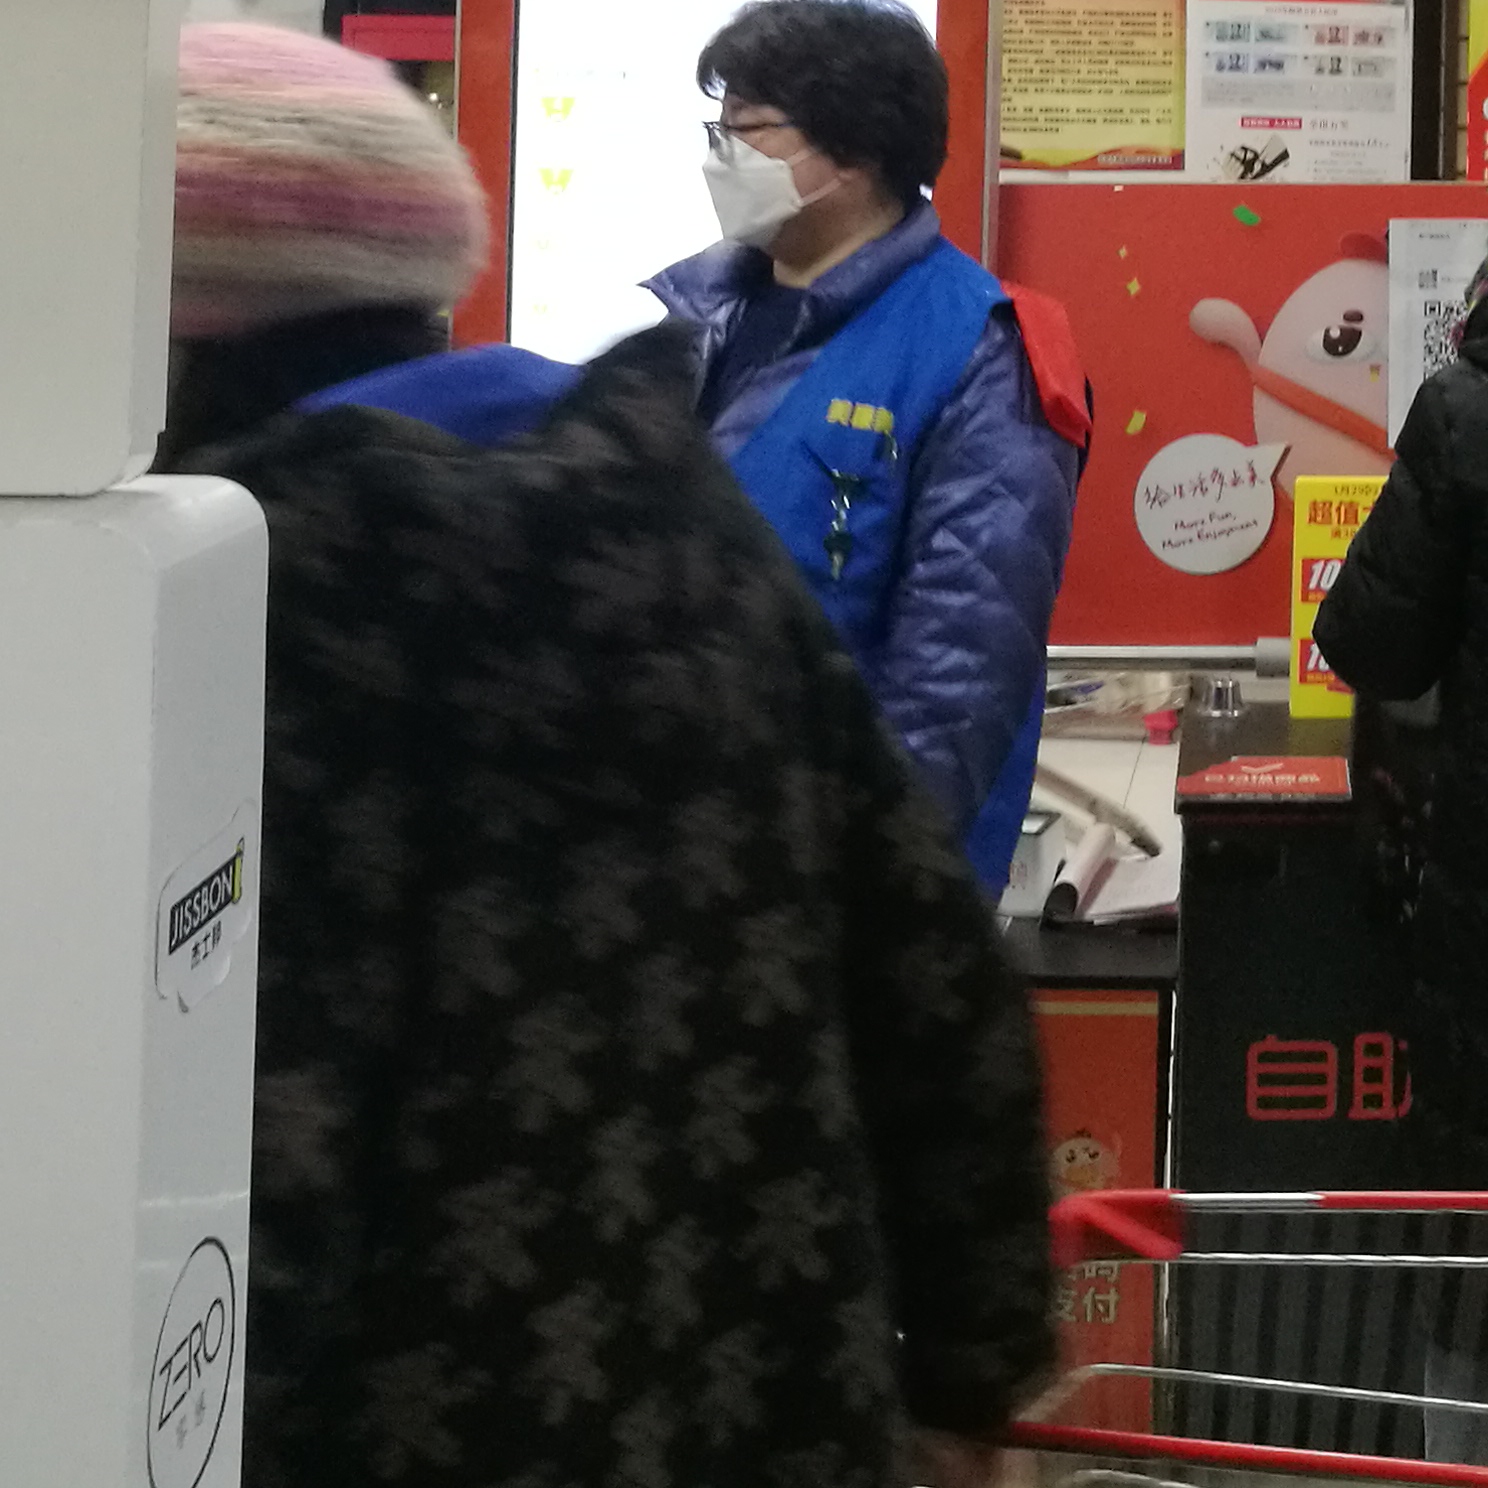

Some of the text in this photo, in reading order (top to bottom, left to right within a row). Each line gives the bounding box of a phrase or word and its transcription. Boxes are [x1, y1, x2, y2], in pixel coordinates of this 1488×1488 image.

[1307, 499, 1374, 525] 超值
[171, 864, 233, 947] JISSBON
[158, 1297, 225, 1431] ZERO
